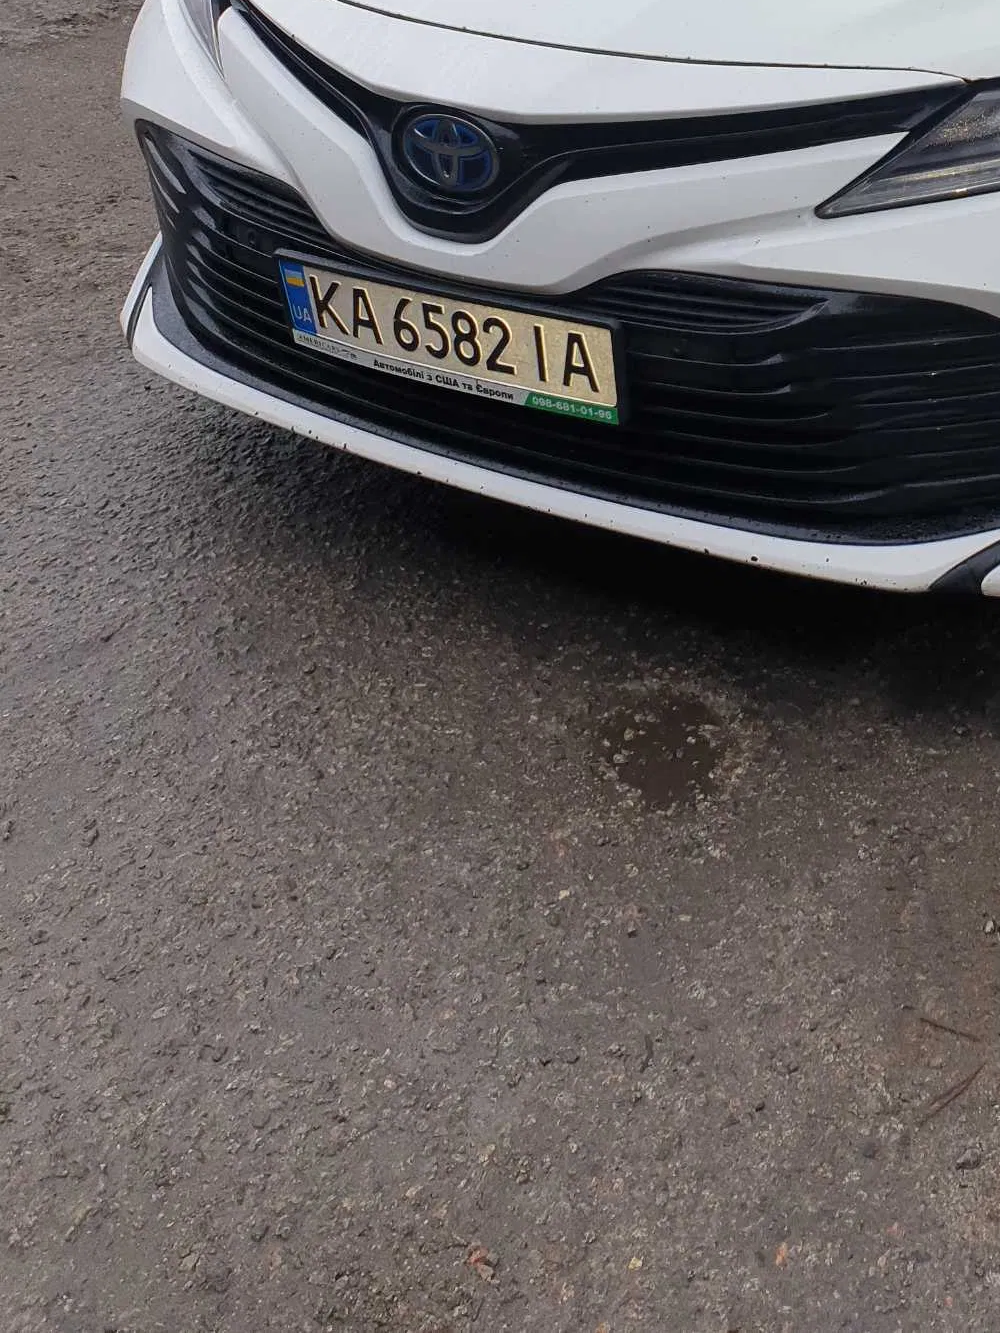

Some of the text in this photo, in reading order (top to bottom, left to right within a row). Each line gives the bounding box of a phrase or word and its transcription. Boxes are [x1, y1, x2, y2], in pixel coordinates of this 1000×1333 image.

[292, 305, 313, 323] UA
[309, 274, 601, 394] KA 6582 IA
[373, 358, 425, 380] Автомобілі
[435, 374, 460, 388] США
[462, 382, 474, 391] та
